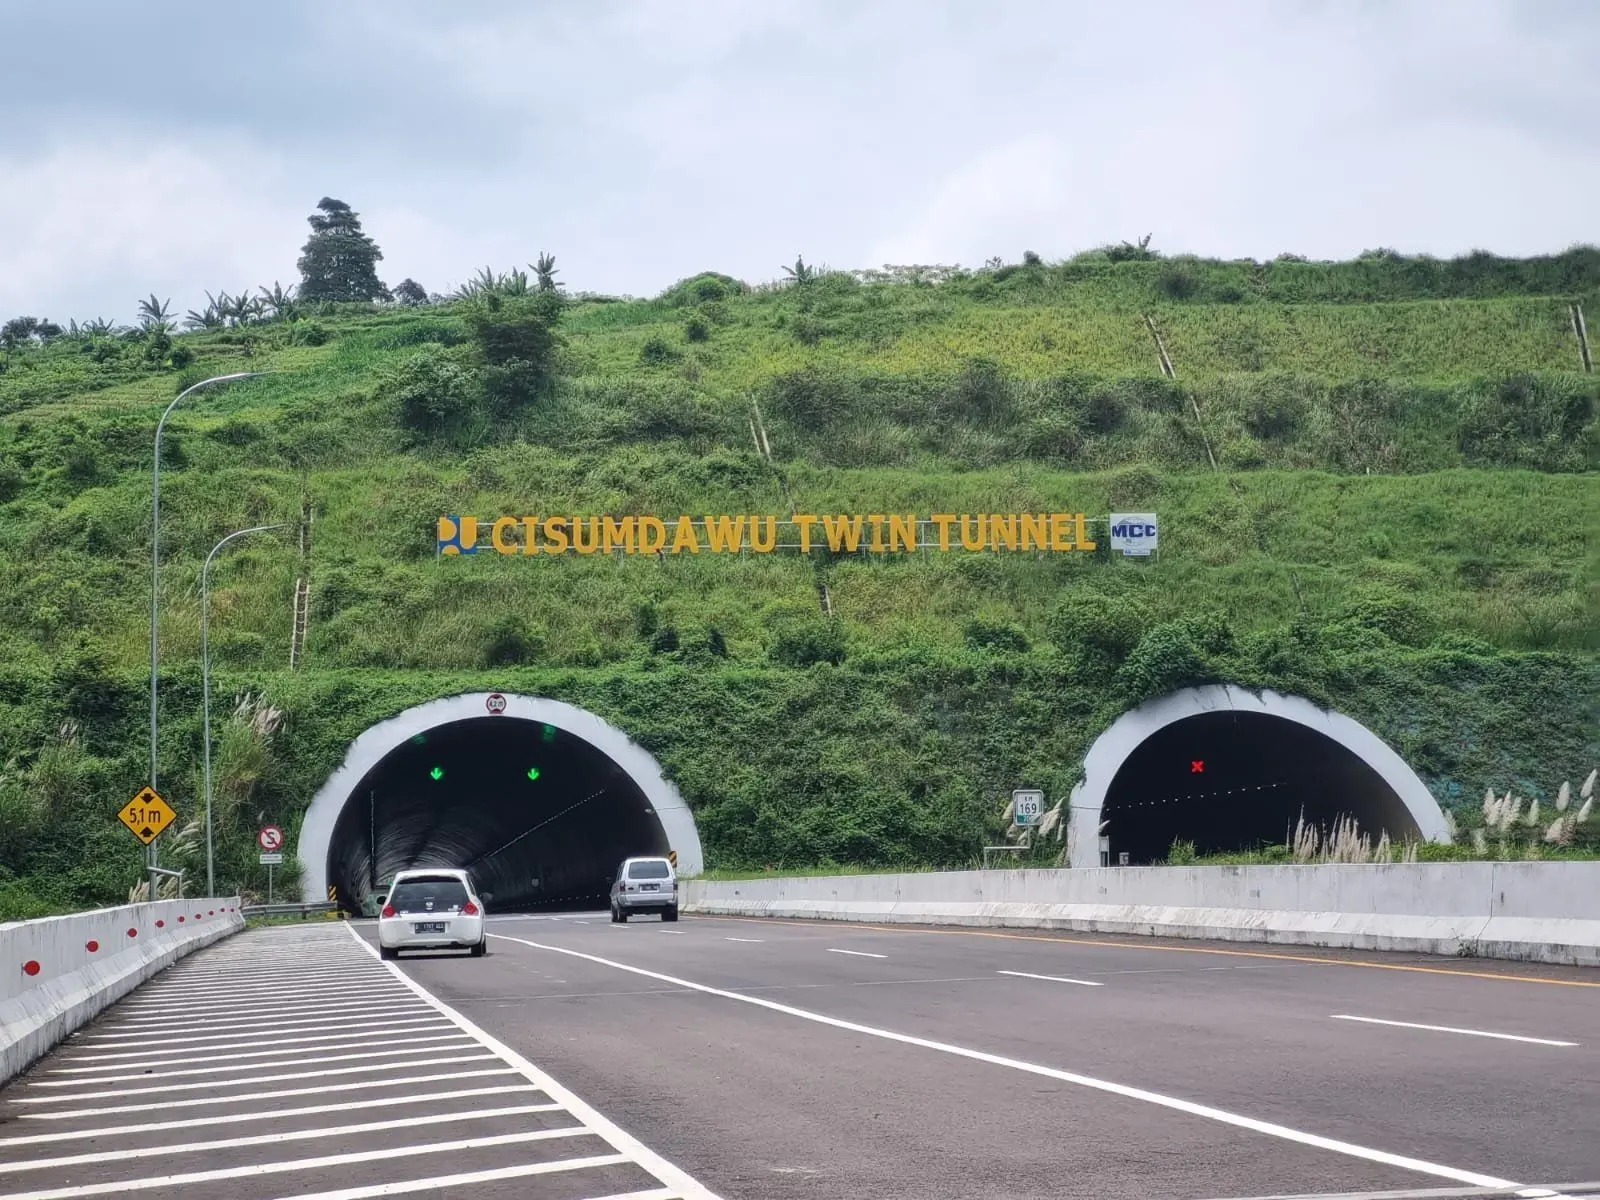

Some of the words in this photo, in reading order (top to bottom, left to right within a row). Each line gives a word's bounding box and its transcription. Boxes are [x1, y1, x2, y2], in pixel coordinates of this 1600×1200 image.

[491, 515, 776, 554] CISUMDAWU
[791, 513, 917, 553] TWIN
[930, 513, 1096, 551] TUNNEL
[1112, 524, 1156, 537] MCC
[1020, 803, 1037, 814] 169
[129, 808, 145, 825] 5,1
[148, 810, 161, 823] m
